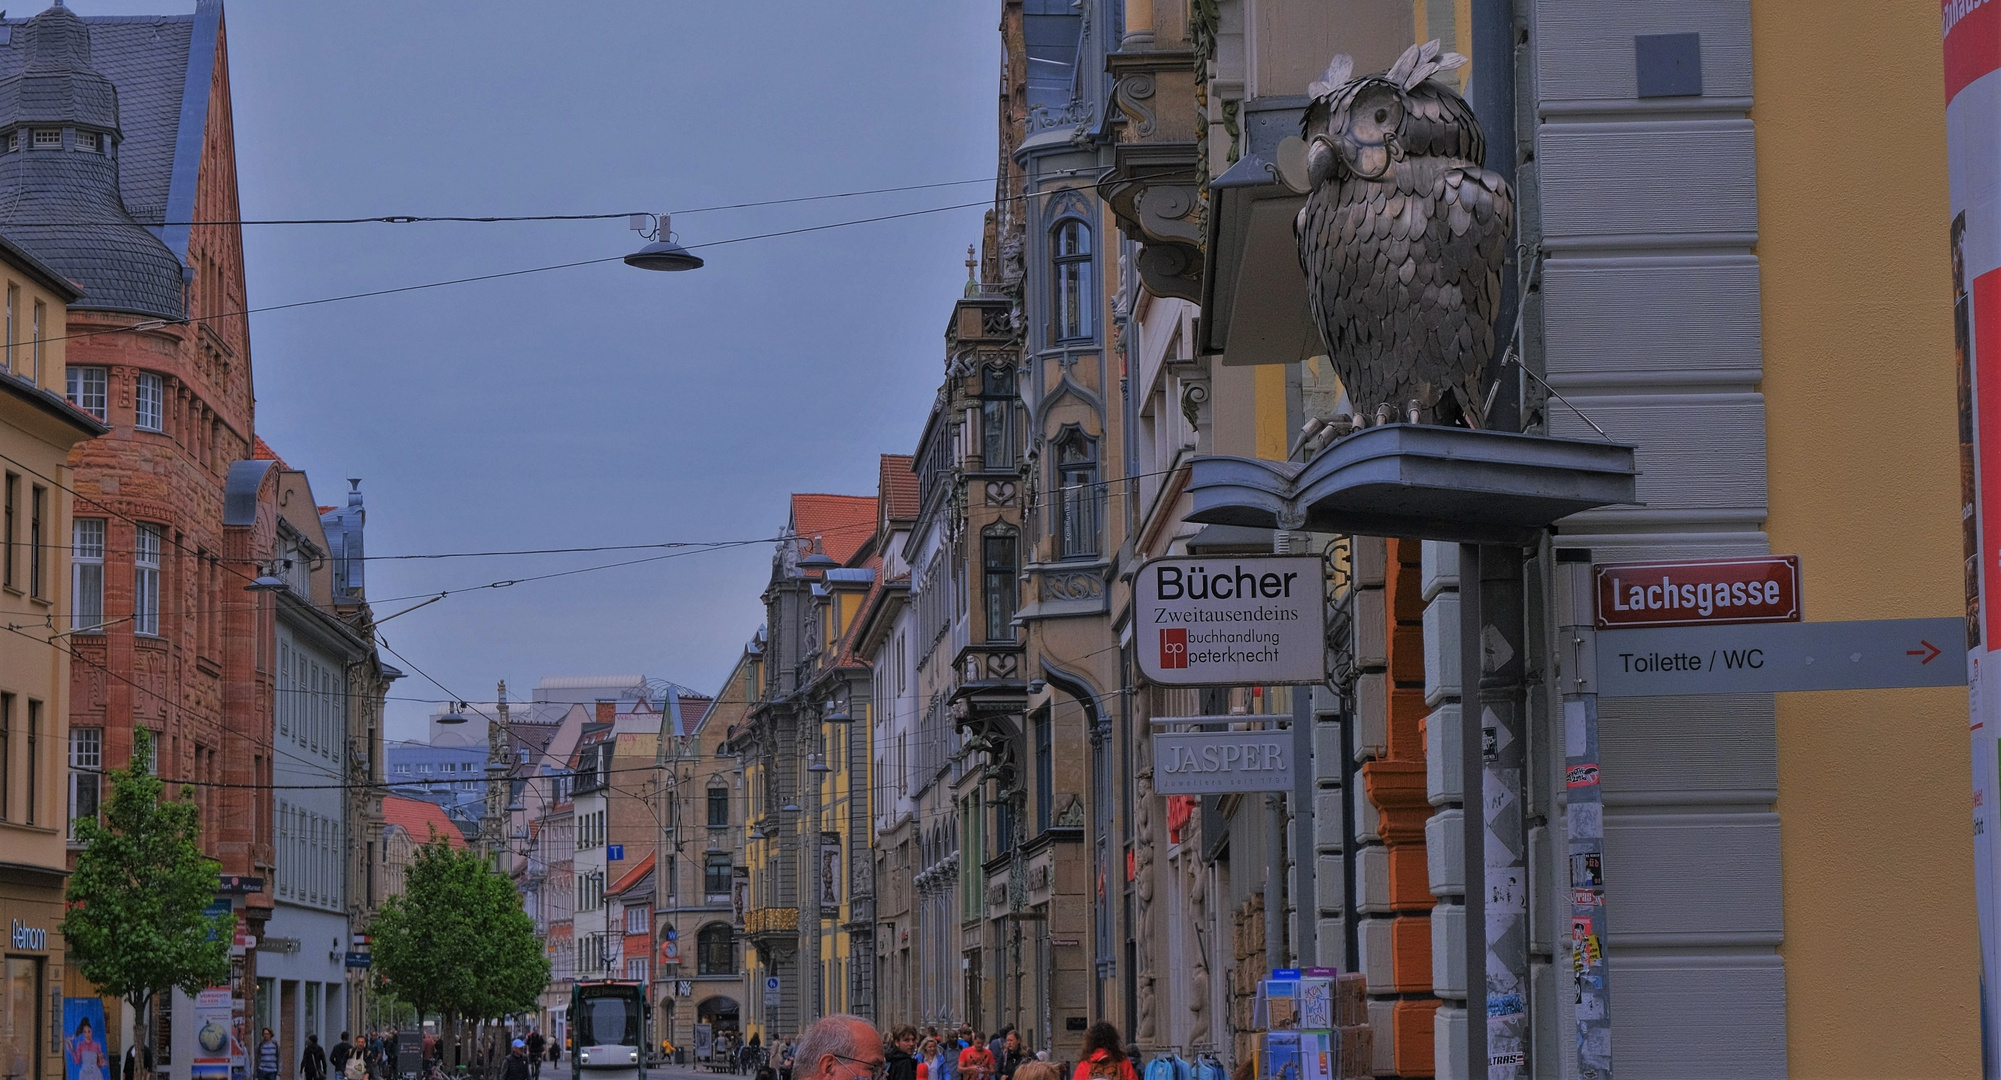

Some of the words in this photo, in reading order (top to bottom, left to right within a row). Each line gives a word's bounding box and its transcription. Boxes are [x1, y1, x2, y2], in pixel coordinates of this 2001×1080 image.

[1156, 565, 1297, 600] Bücher
[1613, 577, 1780, 616] Lachsgasse
[1154, 606, 1299, 624] Zweitausendeins
[1188, 628, 1280, 645] buchhandlung
[1188, 646, 1279, 667] peterknecht
[1619, 653, 1702, 673] Toilette
[1709, 650, 1717, 672] /
[1723, 649, 1764, 670] WC
[1164, 742, 1287, 774] JASPER
[1163, 778, 1223, 787] Juweliere
[1230, 777, 1253, 785] seit
[1260, 777, 1288, 785] 1797
[610, 845, 621, 860] T
[12, 918, 47, 951] fielmann
[1489, 1055, 1517, 1066] LTRAS
